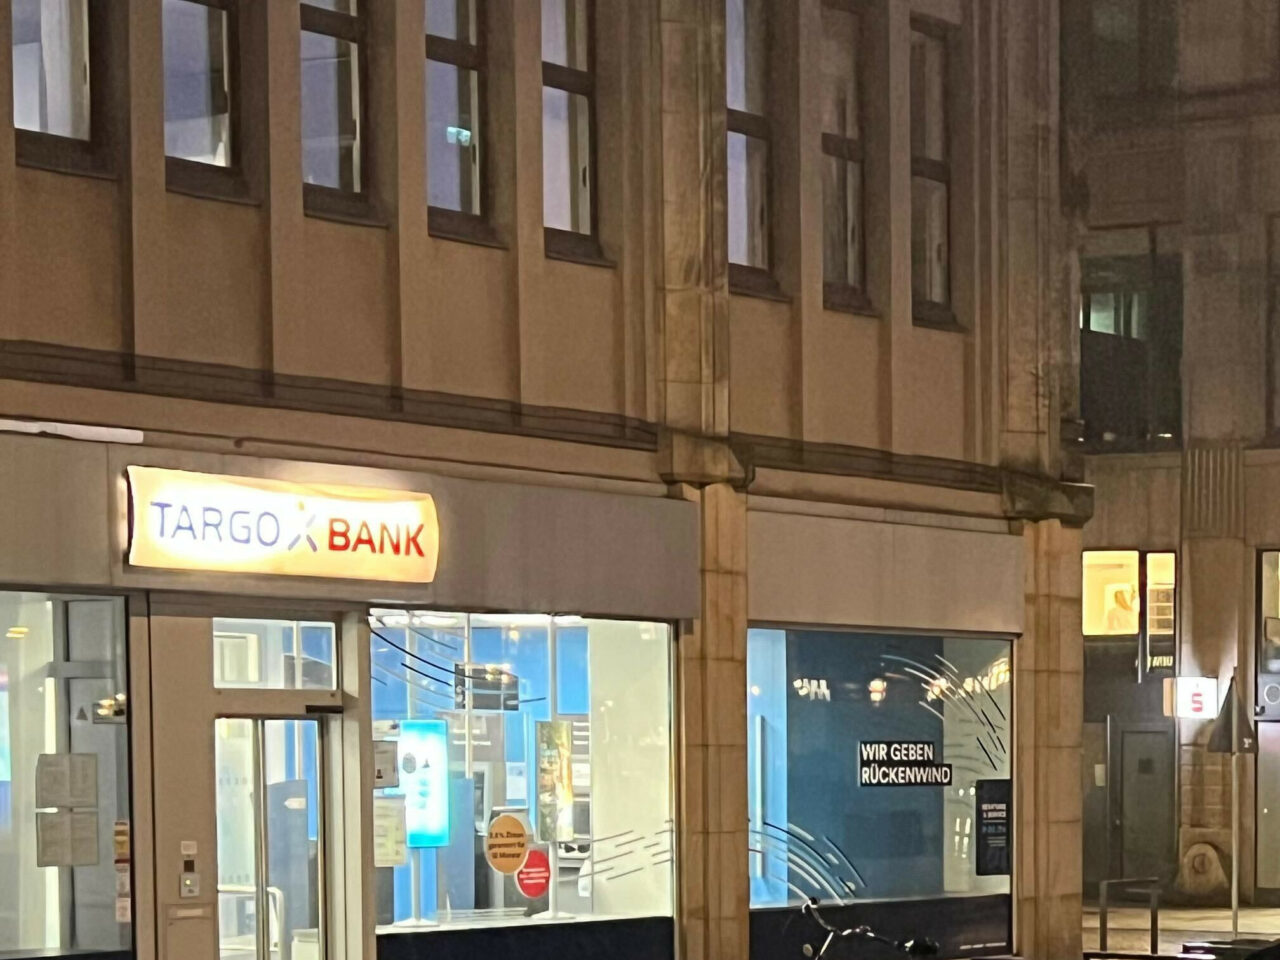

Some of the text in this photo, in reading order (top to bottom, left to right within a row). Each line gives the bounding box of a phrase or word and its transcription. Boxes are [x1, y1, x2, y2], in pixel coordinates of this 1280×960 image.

[150, 501, 425, 557] TARGO BANK
[861, 743, 934, 761] WIR GEBEN
[861, 763, 951, 784] RÜCKENWIND
